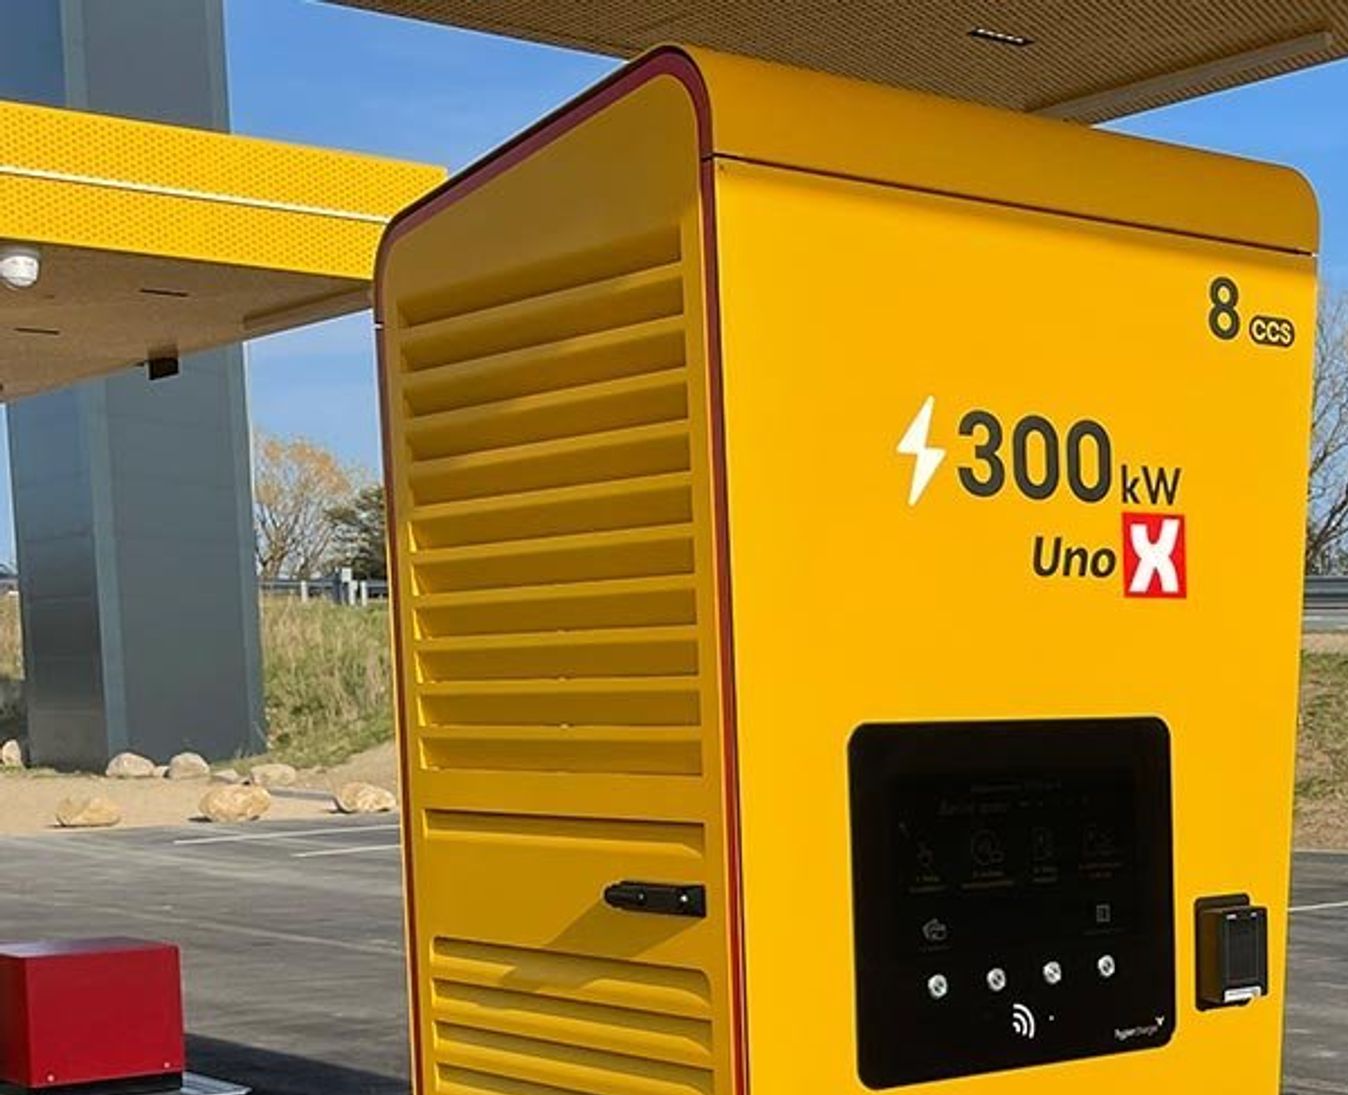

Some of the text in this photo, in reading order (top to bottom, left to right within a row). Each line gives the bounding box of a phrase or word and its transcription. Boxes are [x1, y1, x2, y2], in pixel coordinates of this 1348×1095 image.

[1208, 276, 1241, 341] 8
[957, 410, 1181, 506] 300 kW
[1033, 536, 1117, 578] Uno
